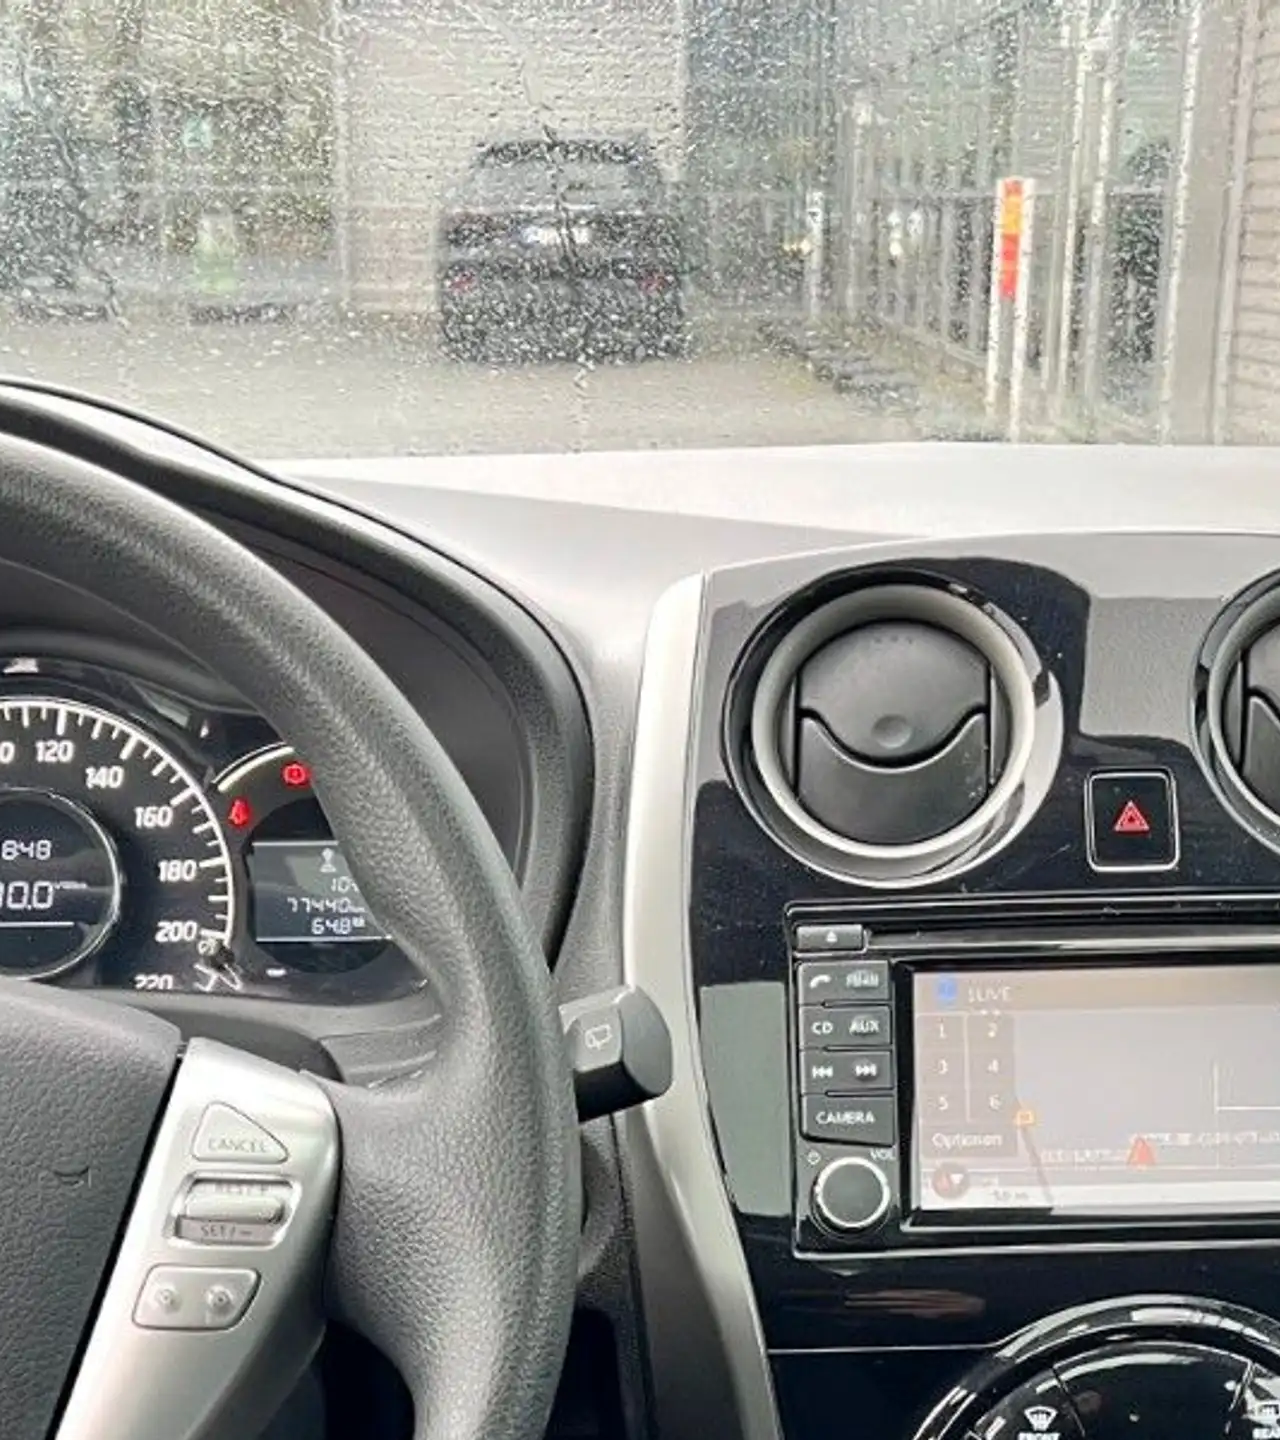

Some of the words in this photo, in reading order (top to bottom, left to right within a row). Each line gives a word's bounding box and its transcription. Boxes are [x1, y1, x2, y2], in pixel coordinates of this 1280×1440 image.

[36, 739, 74, 763] 120
[85, 765, 124, 789] 140
[135, 805, 173, 829] 160
[158, 859, 197, 883] 180
[155, 920, 198, 943] 200
[811, 1020, 834, 1034] CD
[849, 1018, 881, 1034] AUX
[815, 1111, 876, 1125] CAMERA
[208, 1138, 273, 1153] CANCEL
